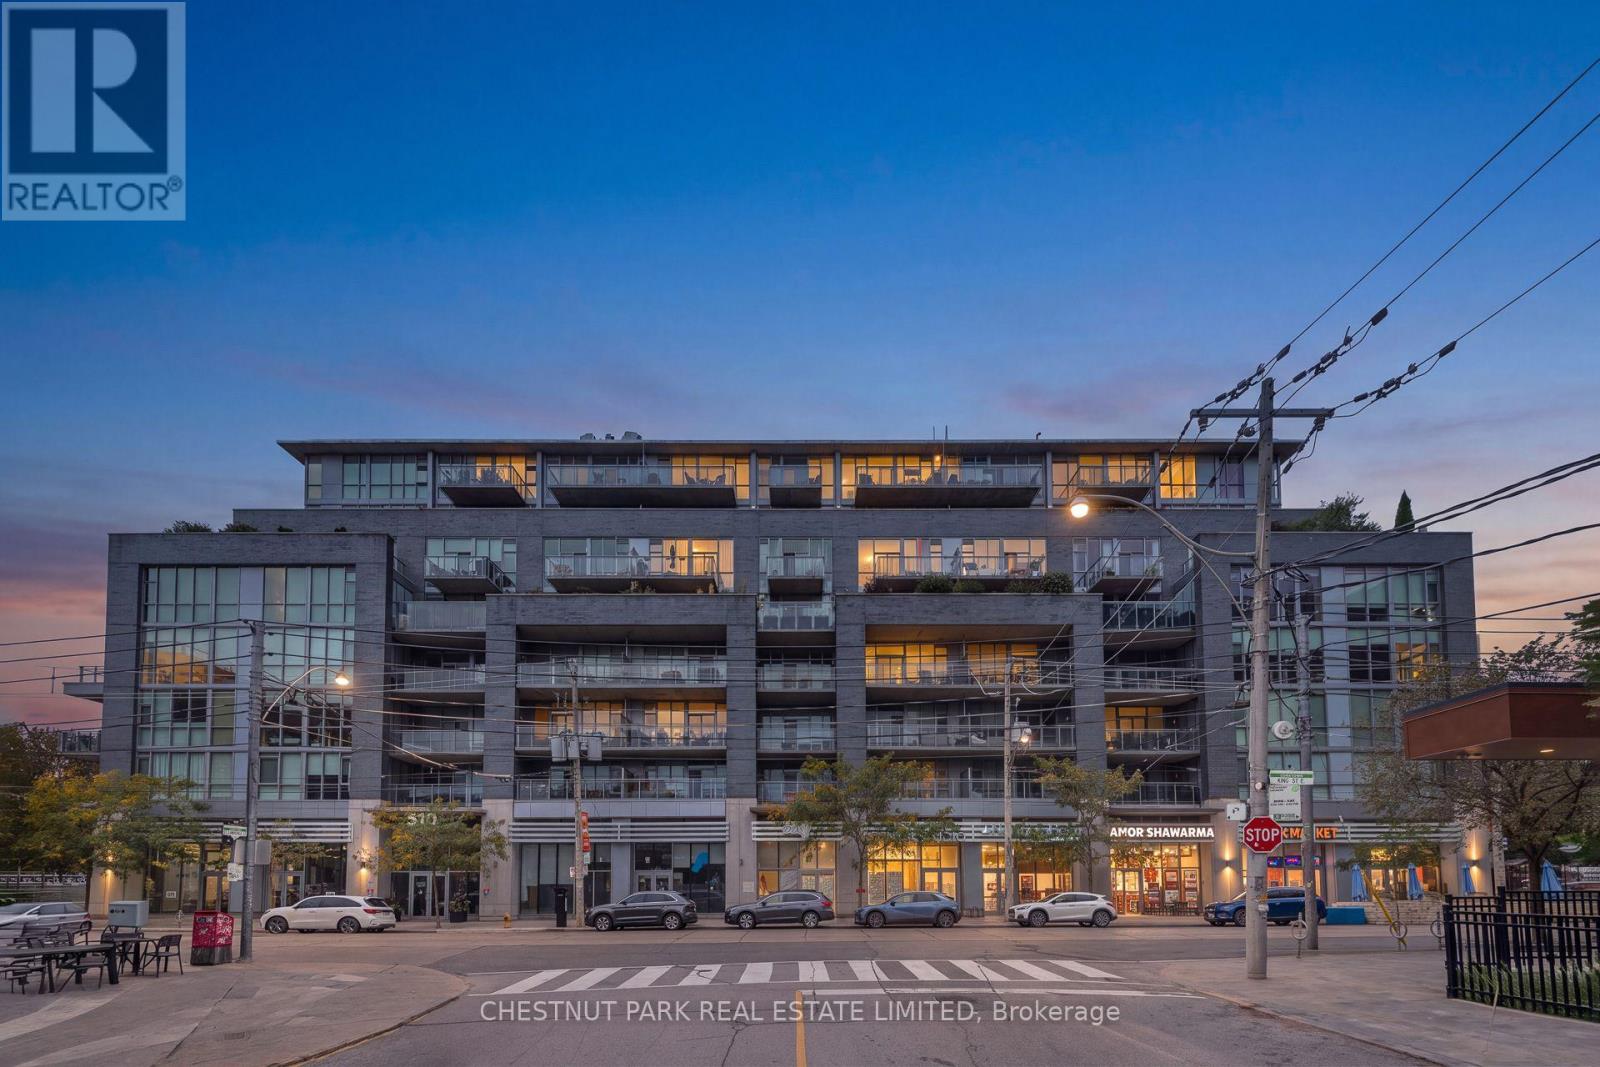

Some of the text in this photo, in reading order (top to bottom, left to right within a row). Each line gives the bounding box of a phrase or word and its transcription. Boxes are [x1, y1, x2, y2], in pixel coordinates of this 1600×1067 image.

[1110, 827, 1215, 838] AMOR SHAWARMA
[1246, 828, 1280, 842] STOP
